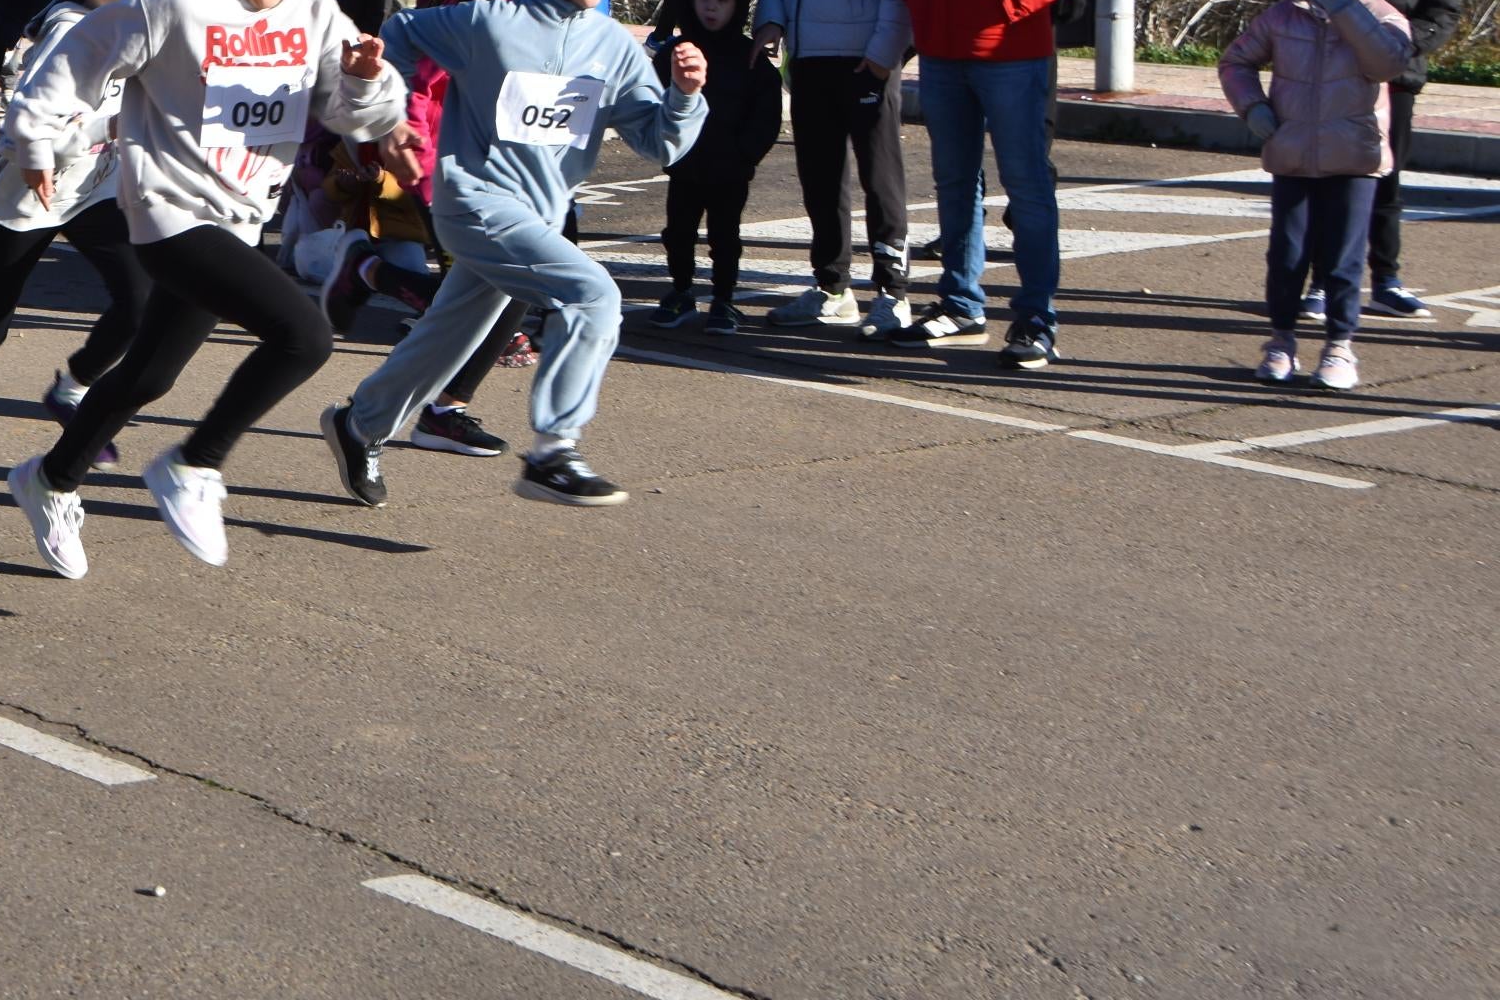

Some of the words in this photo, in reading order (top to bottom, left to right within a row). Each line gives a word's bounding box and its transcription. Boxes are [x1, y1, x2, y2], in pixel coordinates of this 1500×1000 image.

[205, 18, 308, 59] Rolling
[232, 100, 285, 128] 090
[521, 105, 572, 129] 052
